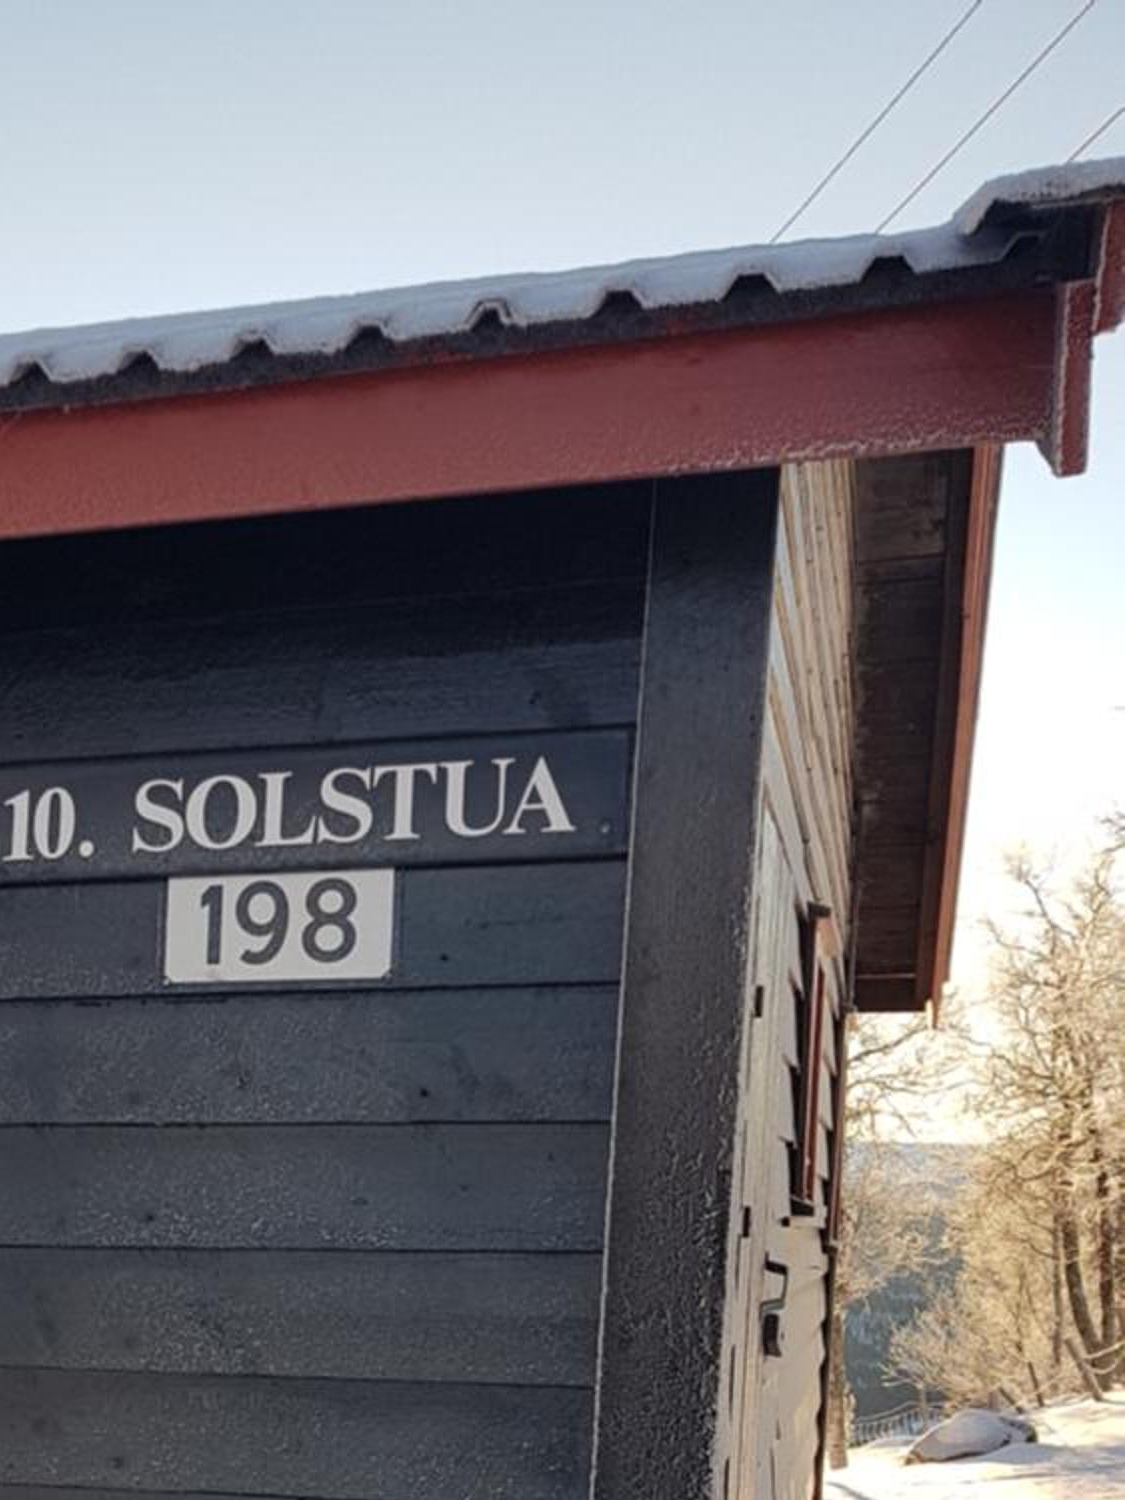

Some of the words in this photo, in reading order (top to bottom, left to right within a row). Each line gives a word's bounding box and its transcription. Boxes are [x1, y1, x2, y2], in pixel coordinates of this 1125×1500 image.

[3, 787, 94, 861] 10.
[132, 757, 575, 853] SOLSTUA
[200, 877, 357, 965] 198
